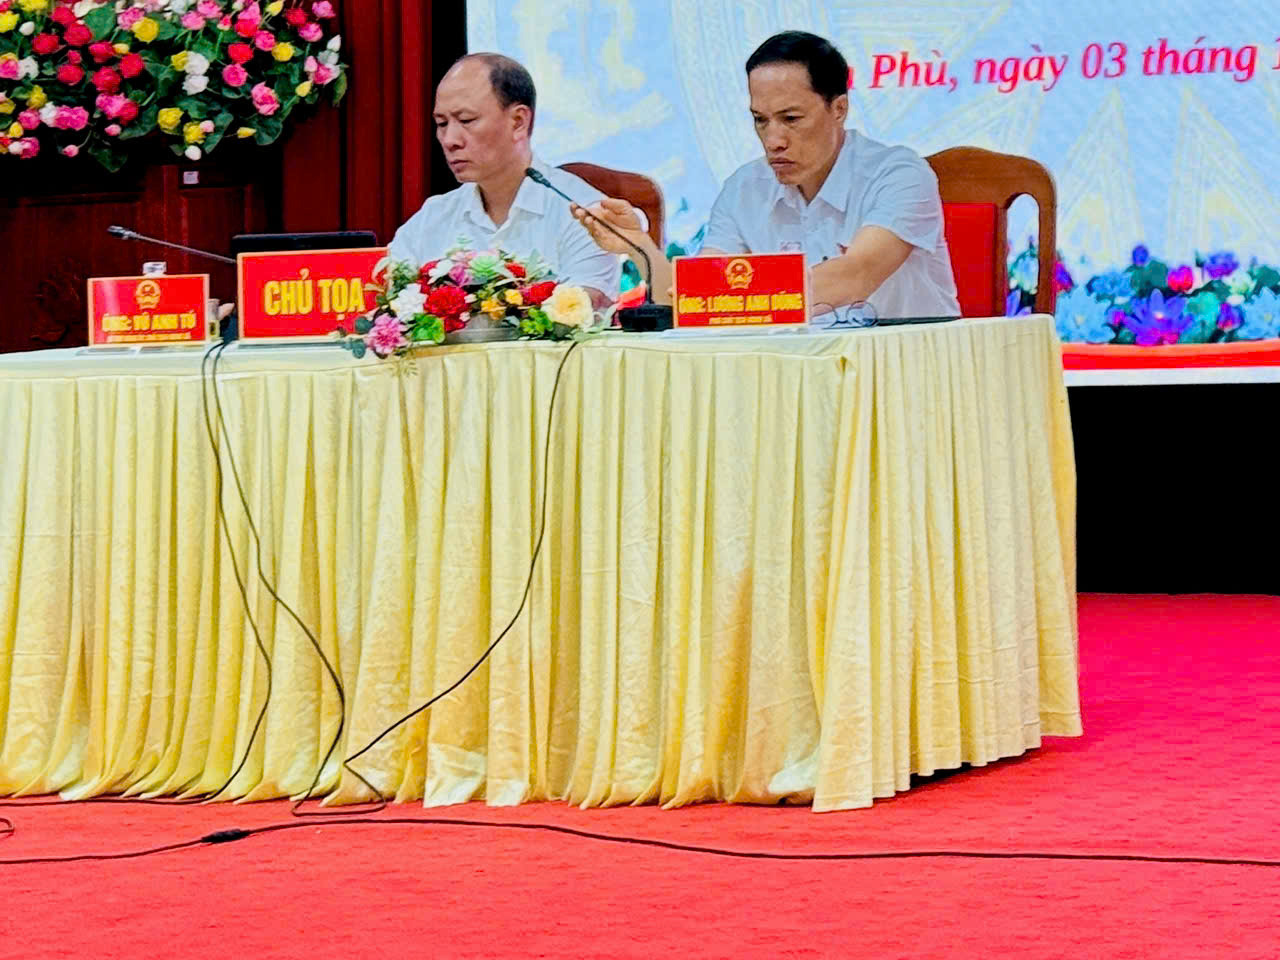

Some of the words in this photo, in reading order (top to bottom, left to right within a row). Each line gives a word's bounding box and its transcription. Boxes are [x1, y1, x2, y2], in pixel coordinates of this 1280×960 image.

[868, 49, 958, 94] Phù,
[973, 43, 1069, 94] ngày
[1081, 41, 1127, 79] 03
[1143, 39, 1258, 81] tháng
[264, 267, 313, 316] CHỦ
[317, 277, 366, 321] TỌA
